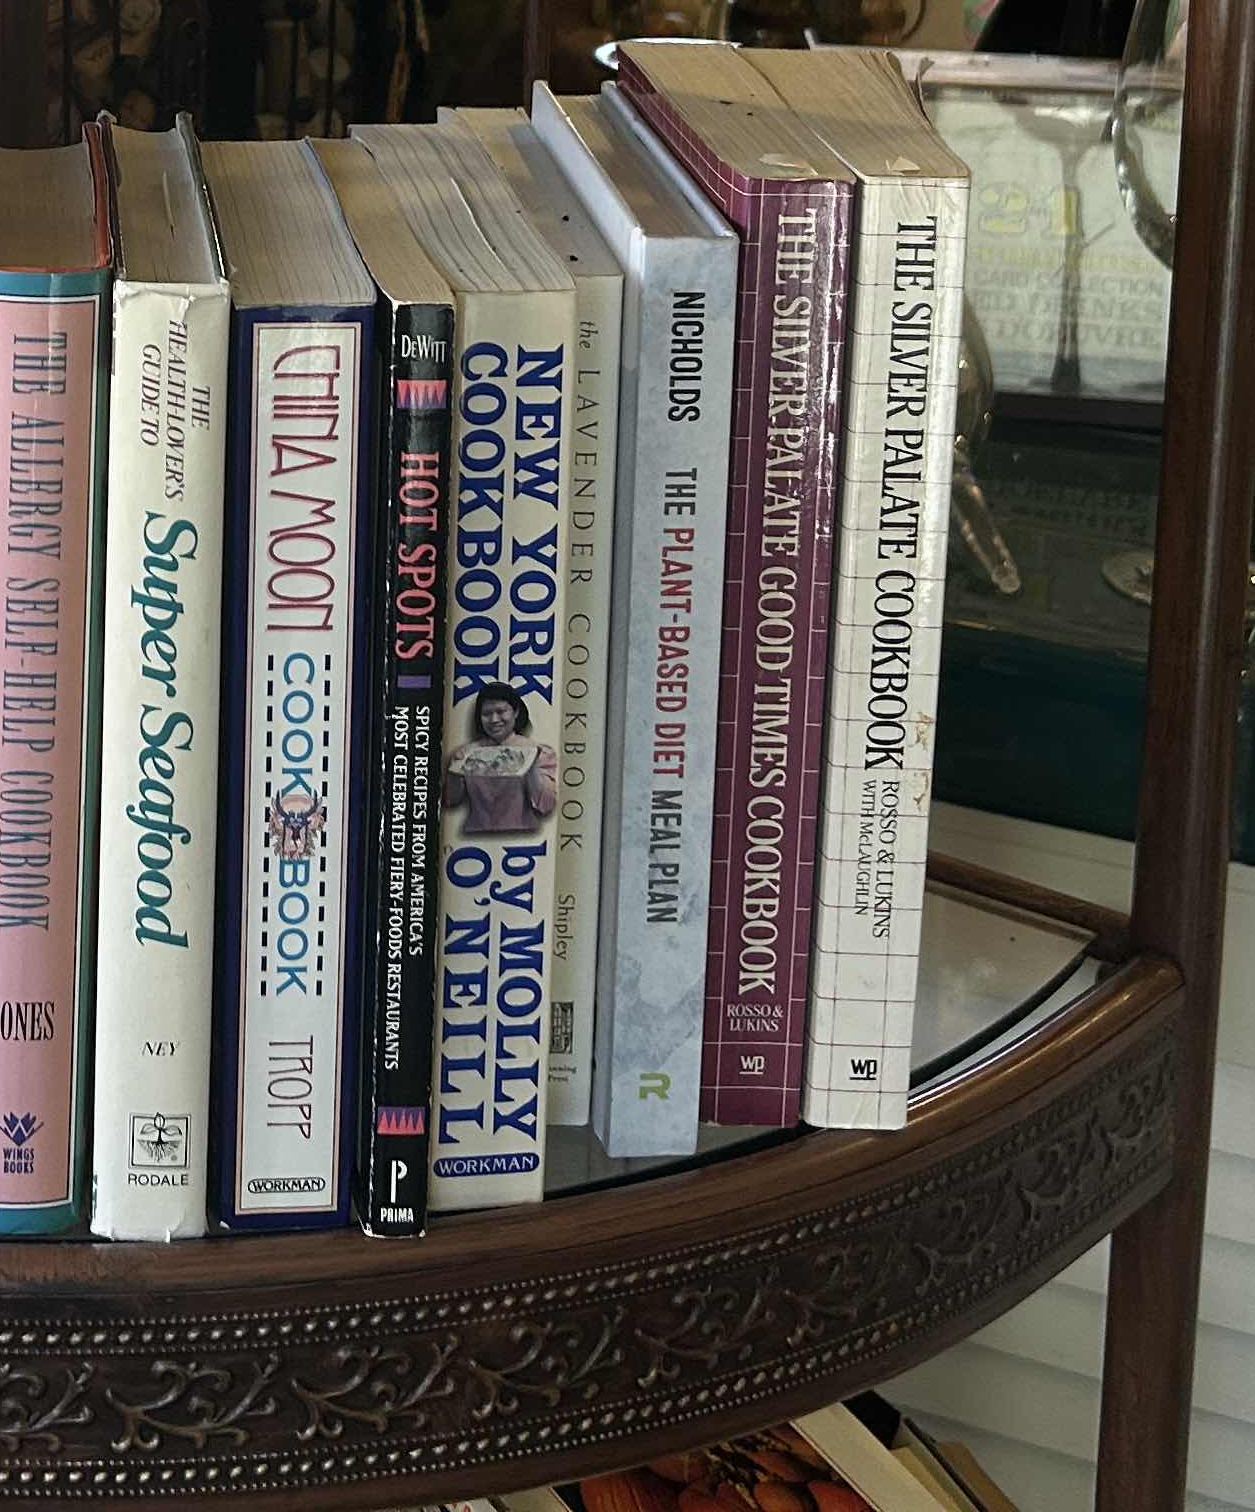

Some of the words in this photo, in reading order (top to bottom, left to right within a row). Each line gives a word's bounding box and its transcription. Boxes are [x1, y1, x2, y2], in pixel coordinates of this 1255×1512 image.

[773, 206, 817, 286] THE
[892, 214, 938, 293] THE
[12, 331, 68, 395] THE
[577, 319, 595, 349] the
[667, 290, 706, 424] NICHOLDS
[768, 295, 811, 420] SILVER
[884, 300, 933, 418] SILVER
[191, 385, 211, 431] THE
[512, 342, 565, 511] NEW
[7, 412, 65, 561] ALLERGY
[397, 451, 441, 533] HOT
[569, 369, 602, 585] LAVENDER
[664, 467, 698, 516] THE
[760, 424, 806, 559] PALATE
[876, 426, 926, 560] PALATE
[452, 341, 509, 707] COOKBOOK
[131, 509, 199, 698] Super
[394, 543, 437, 660] SPOTS
[506, 523, 559, 706] YORK
[654, 526, 695, 714] PLANT-BASED
[754, 565, 797, 670] GOOD
[2, 577, 61, 754] SELF-HELP
[863, 569, 918, 771] COOKBOOK
[394, 705, 410, 752] MOST
[414, 705, 431, 751] SPICY
[559, 613, 591, 852] COOKBOOK
[652, 722, 687, 779] DIET
[748, 678, 791, 789] TIMES
[125, 703, 195, 949] Seafood
[389, 754, 408, 853] CELEBRATED
[413, 755, 430, 820] RECIPES
[649, 789, 683, 855] MEAL
[858, 778, 877, 819] WITH
[412, 824, 427, 868] FROM
[489, 839, 547, 915] by
[854, 821, 875, 917] McLAUGHLIN
[386, 856, 406, 959] FIERY-FOODS
[408, 872, 426, 956] AMERICA'S
[553, 894, 576, 961] Shipley
[646, 863, 680, 922] PLAN
[737, 794, 786, 996] COOKBOOK
[141, 1041, 182, 1057] NEY
[384, 961, 403, 1071] RESTAURANTS
[492, 920, 545, 1143] MOLLY
[726, 1003, 769, 1019] ROSSO
[771, 1003, 784, 1019] &
[729, 1018, 780, 1033] LUKINS
[2, 1147, 35, 1160] WINGS
[3, 1161, 35, 1174] BOOKS
[127, 1172, 190, 1187] RODALE
[252, 1177, 321, 1192] WORKMAN
[436, 1156, 537, 1175] WORKMAN
[380, 1206, 414, 1223] PRIMA
